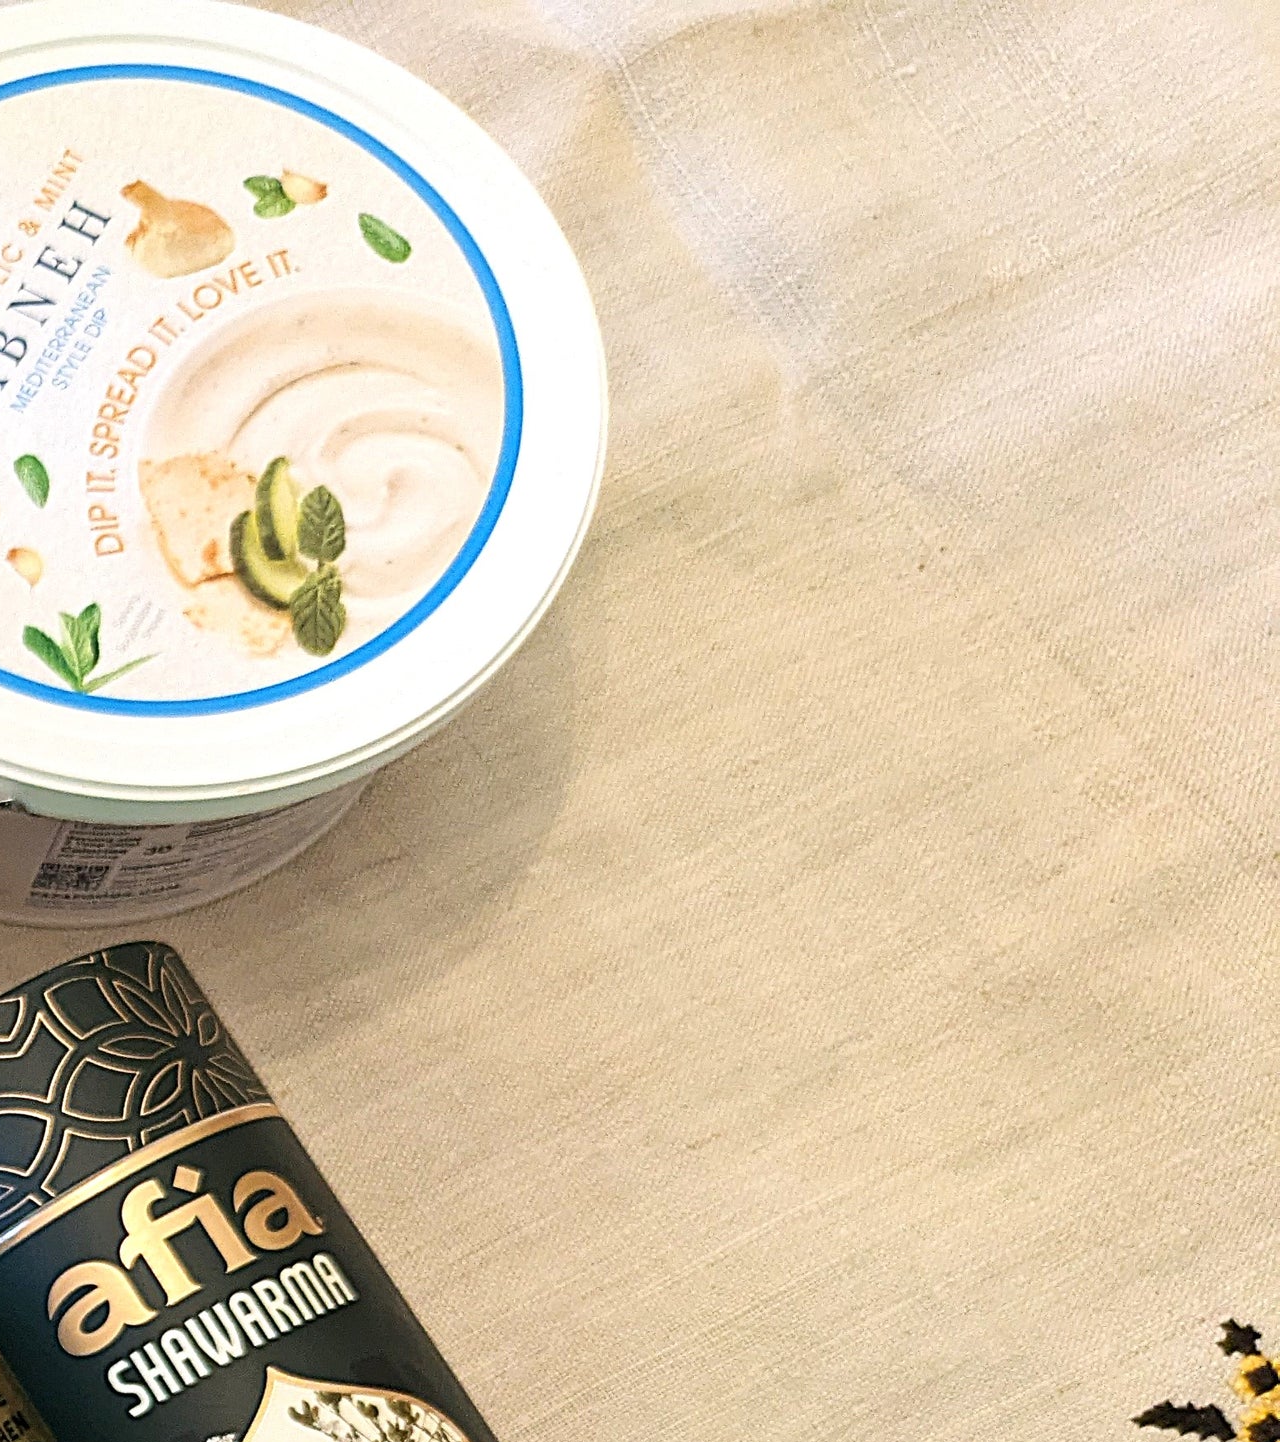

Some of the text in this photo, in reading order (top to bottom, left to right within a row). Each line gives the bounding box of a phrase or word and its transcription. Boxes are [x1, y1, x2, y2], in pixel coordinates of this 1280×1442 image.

[19, 219, 41, 238] &
[33, 148, 83, 212] MINT
[10, 265, 113, 412] MEDITERRANEAN
[52, 308, 108, 391] STYLE DIP
[86, 249, 301, 558] DIP IT. SPREAD IT. LOVE IT.
[47, 1164, 323, 1359] afia
[106, 1251, 357, 1418] SHAWARMA
